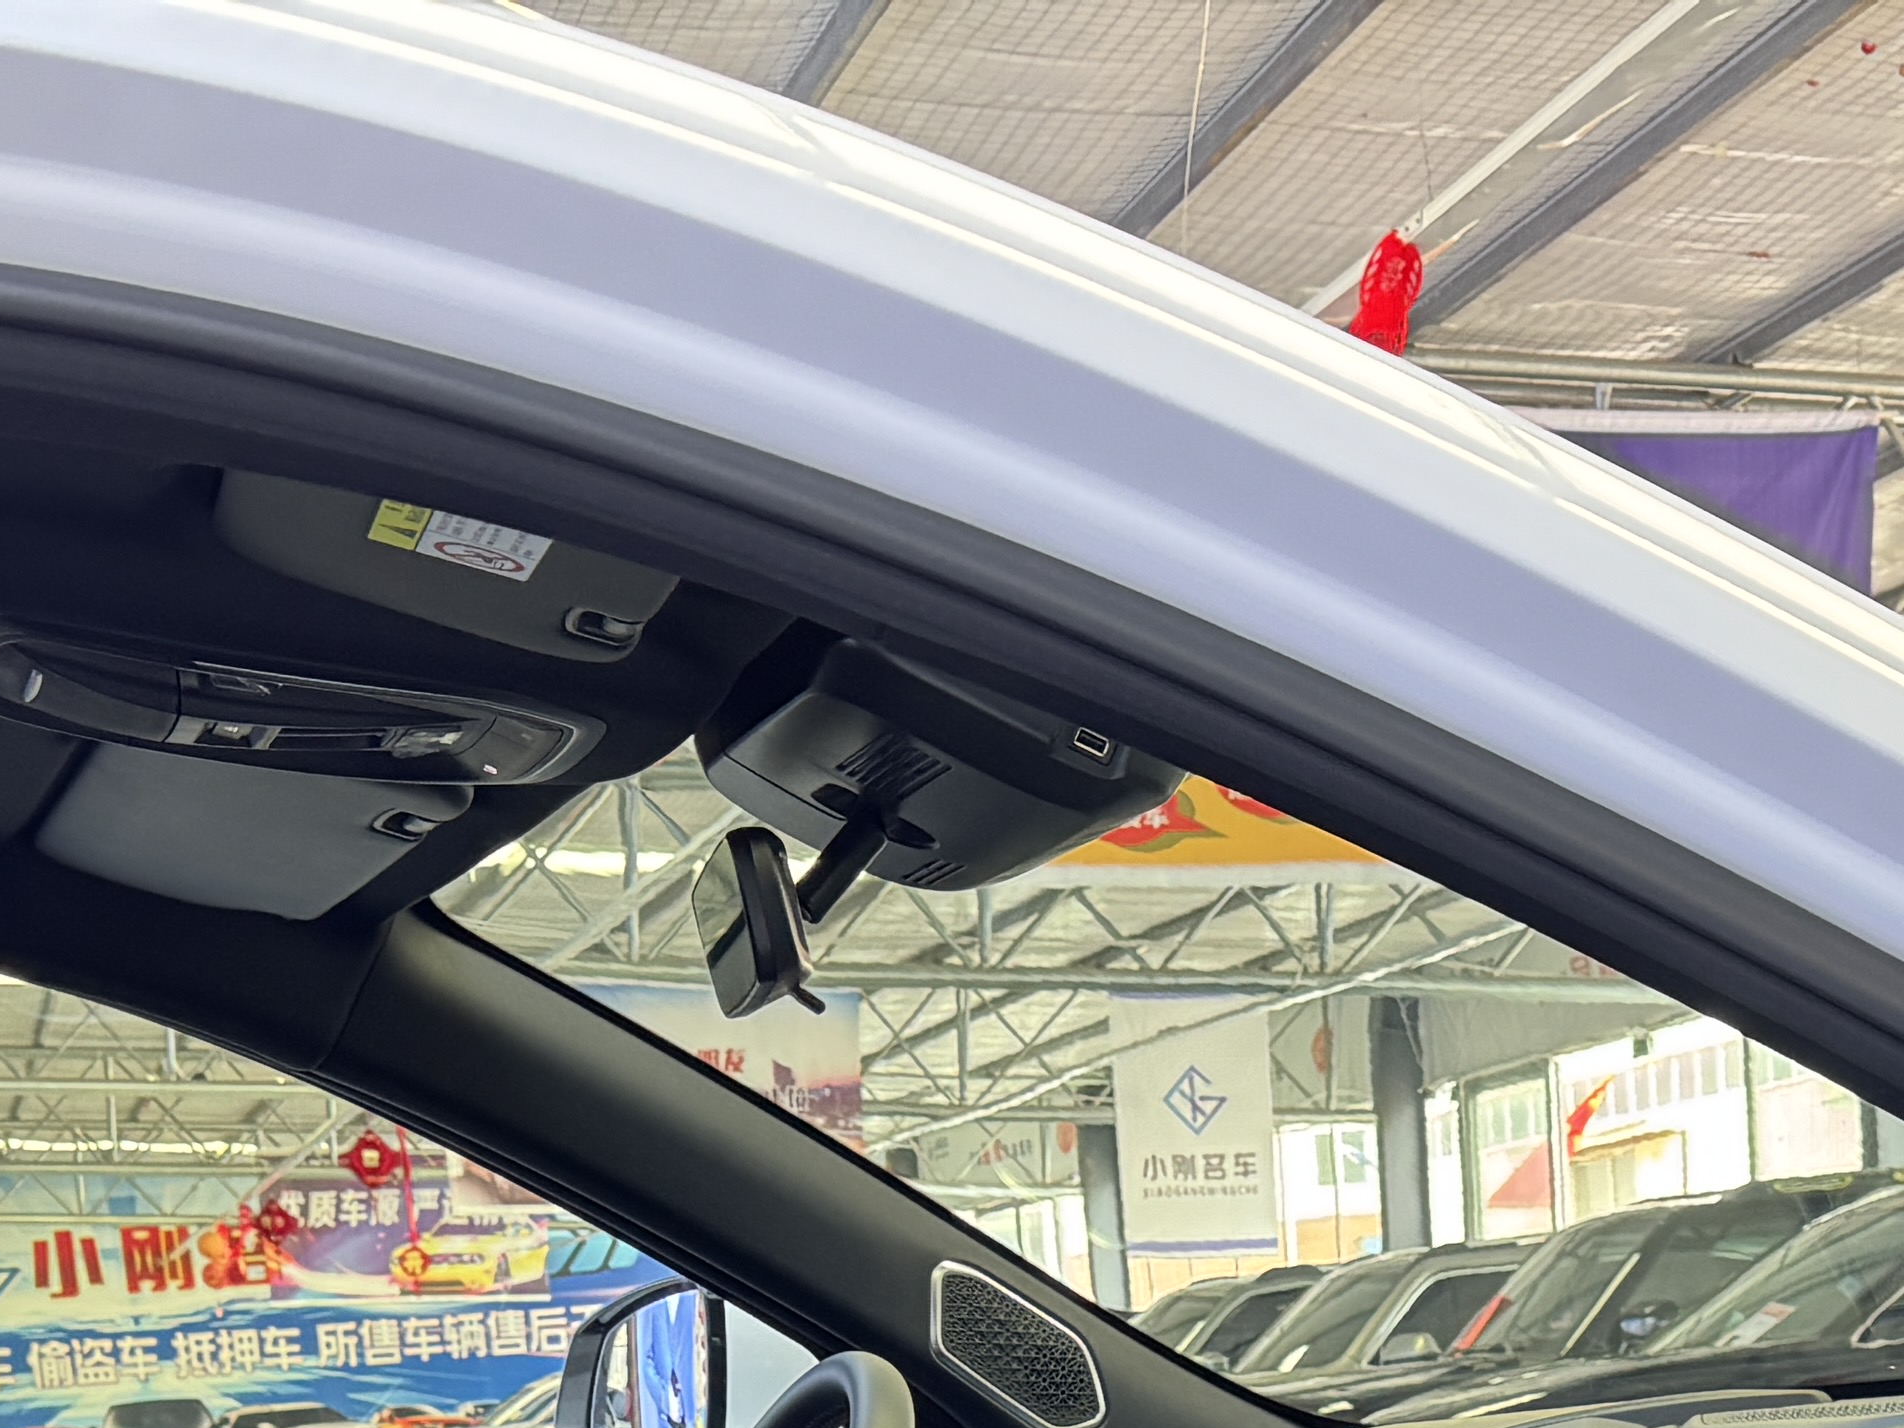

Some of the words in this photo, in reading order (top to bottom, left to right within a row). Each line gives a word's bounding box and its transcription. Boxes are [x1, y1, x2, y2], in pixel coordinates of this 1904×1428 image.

[1142, 1152, 1257, 1181] 小刚名车
[26, 1336, 160, 1389] 偷盗车
[171, 1326, 304, 1378] 抵押车
